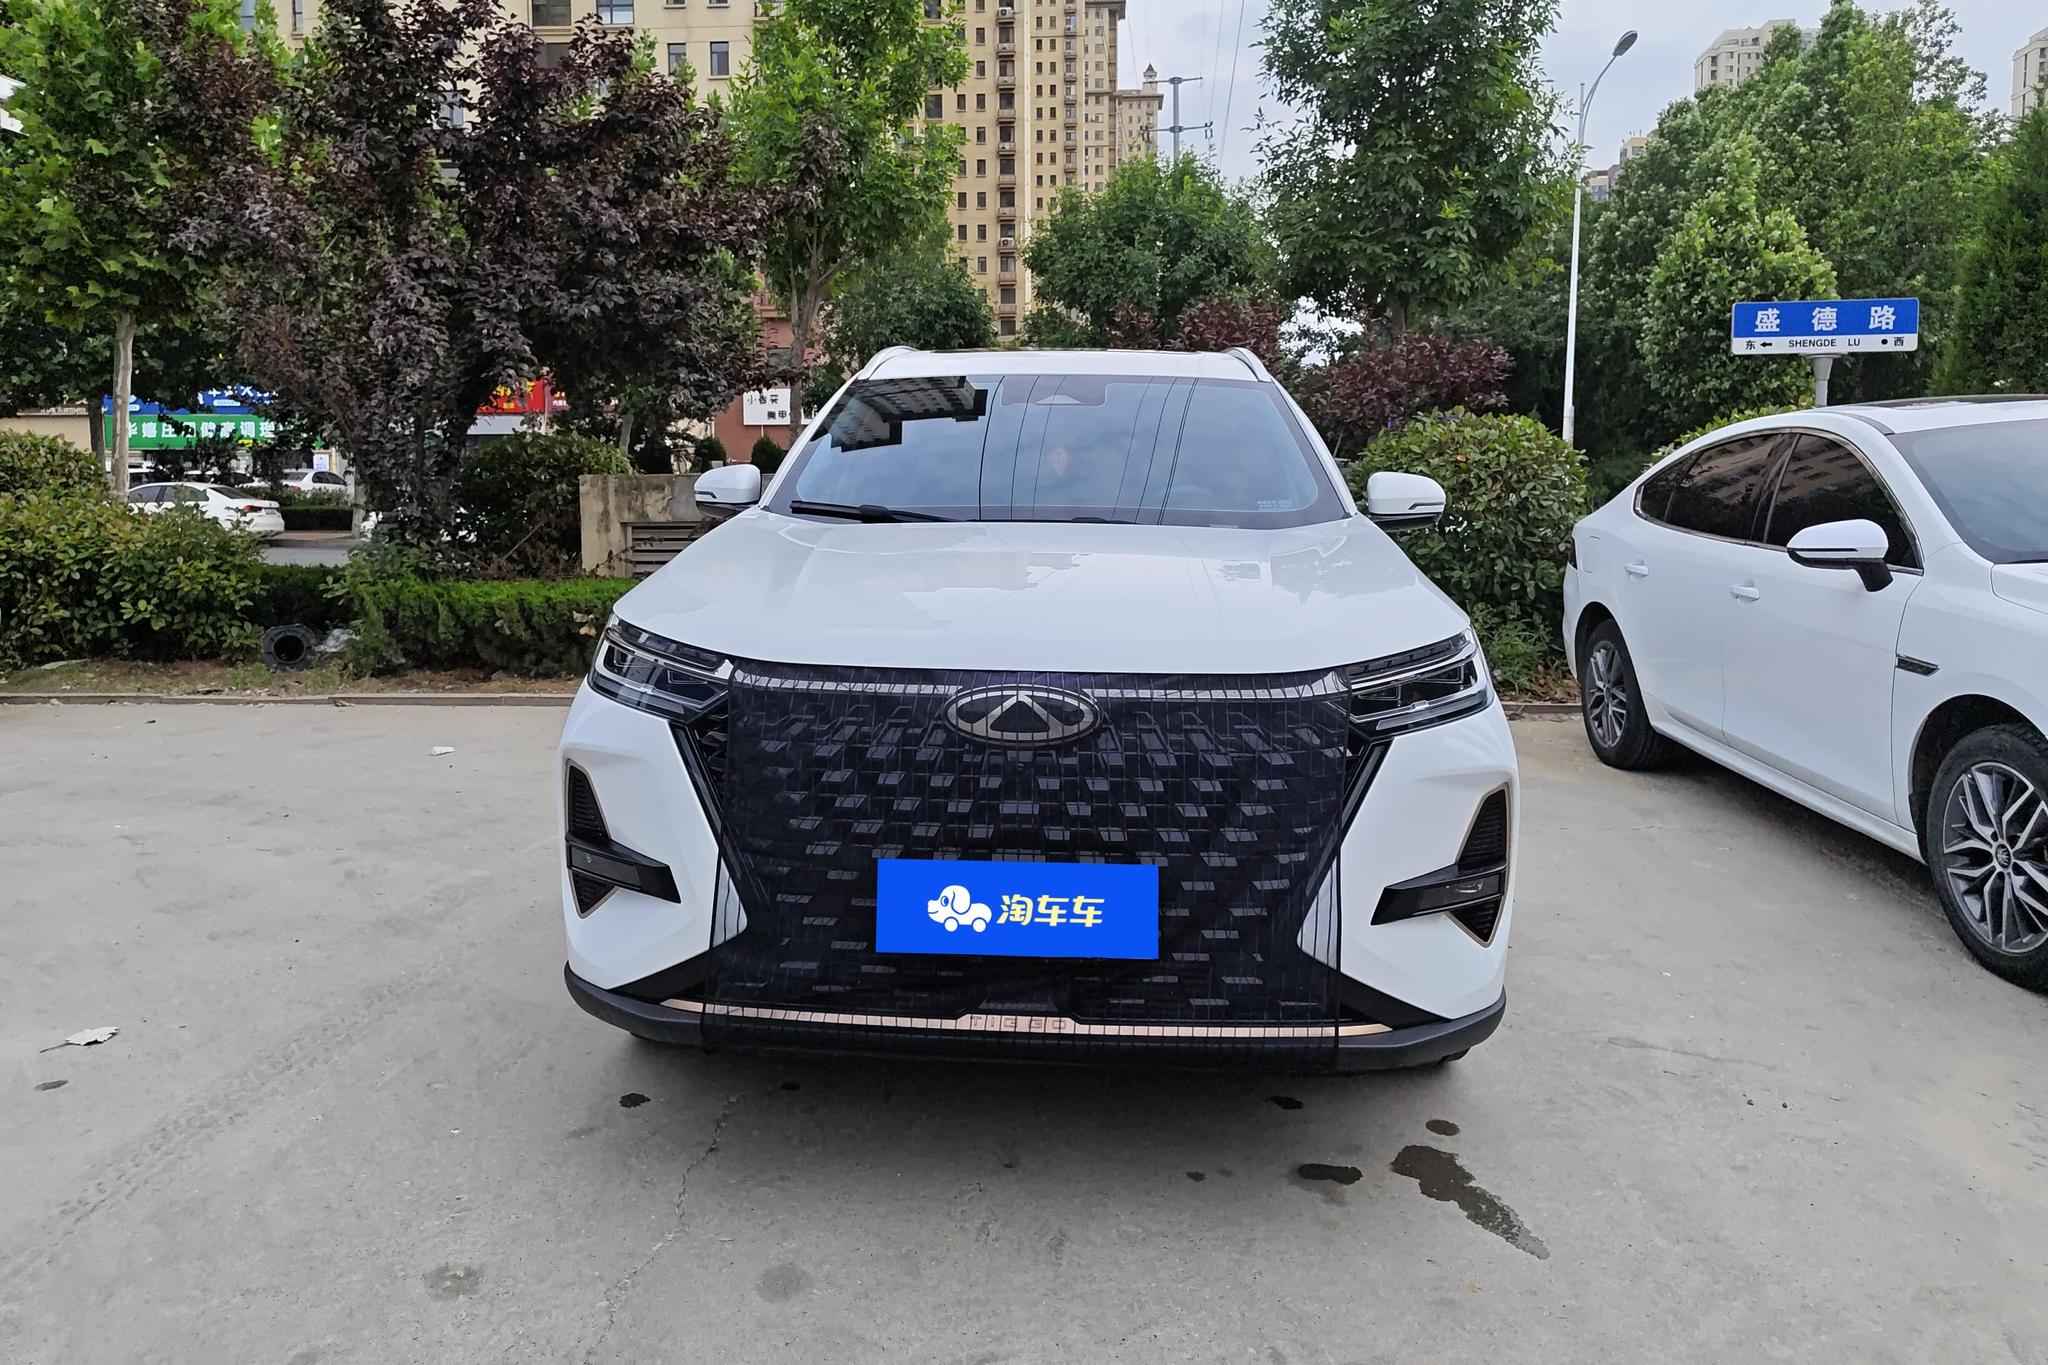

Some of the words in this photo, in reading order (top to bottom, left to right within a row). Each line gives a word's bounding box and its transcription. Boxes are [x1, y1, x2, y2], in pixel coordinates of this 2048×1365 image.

[1754, 304, 1896, 332] 盛德路
[1745, 340, 1756, 350] 东
[1788, 338, 1837, 348] SHENGDE
[1847, 338, 1861, 347] LU
[1893, 336, 1905, 347] 西
[971, 1015, 1067, 1030] TIGGO
